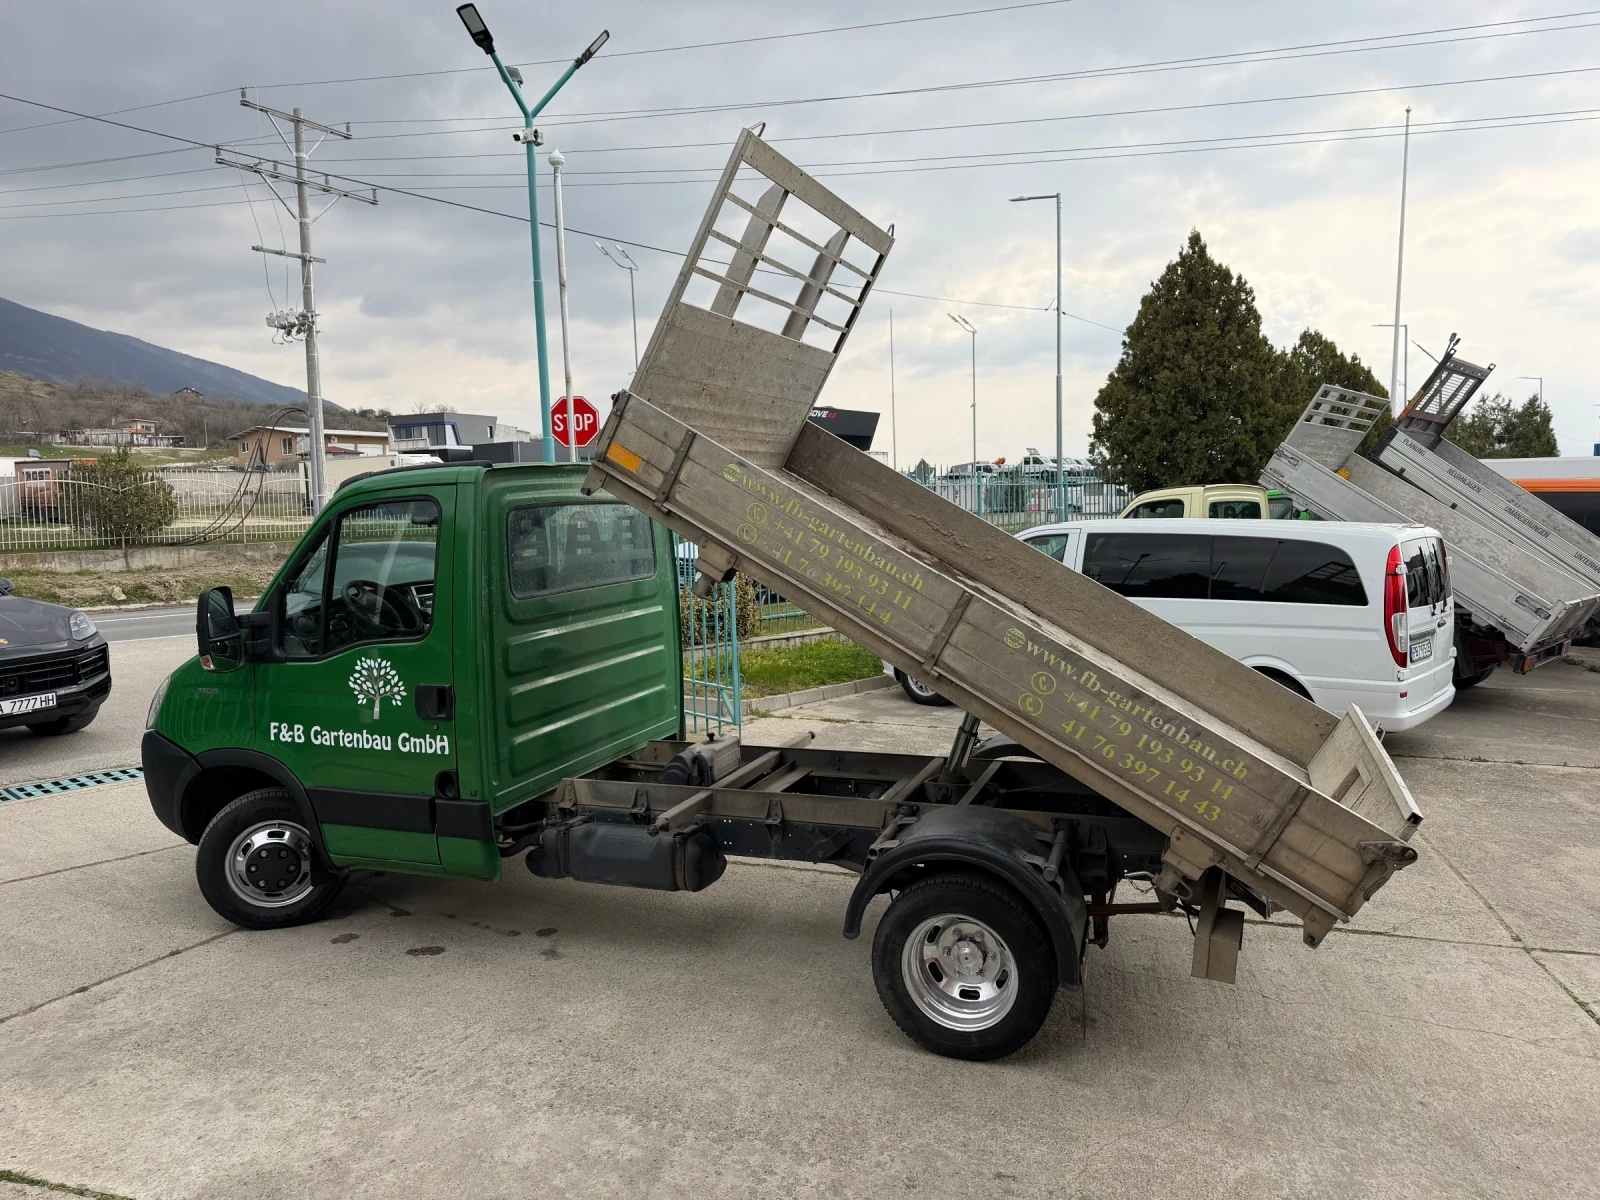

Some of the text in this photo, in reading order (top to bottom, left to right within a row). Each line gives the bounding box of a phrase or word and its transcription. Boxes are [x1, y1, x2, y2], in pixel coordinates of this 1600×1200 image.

[1402, 438, 1427, 457] PLANUNG
[1446, 467, 1482, 493] NEUANLAGEN
[809, 538, 831, 559] 79
[834, 555, 864, 581] 193
[868, 574, 890, 596] 93
[893, 590, 913, 610] 11
[269, 721, 450, 755] F&B Gartenbau GmbH
[1026, 639, 1249, 780] www.fb-gartenbau.ch
[1061, 718, 1222, 822] 41 76 397 14 43
[1063, 691, 1235, 801] +41 79 193 93 11
